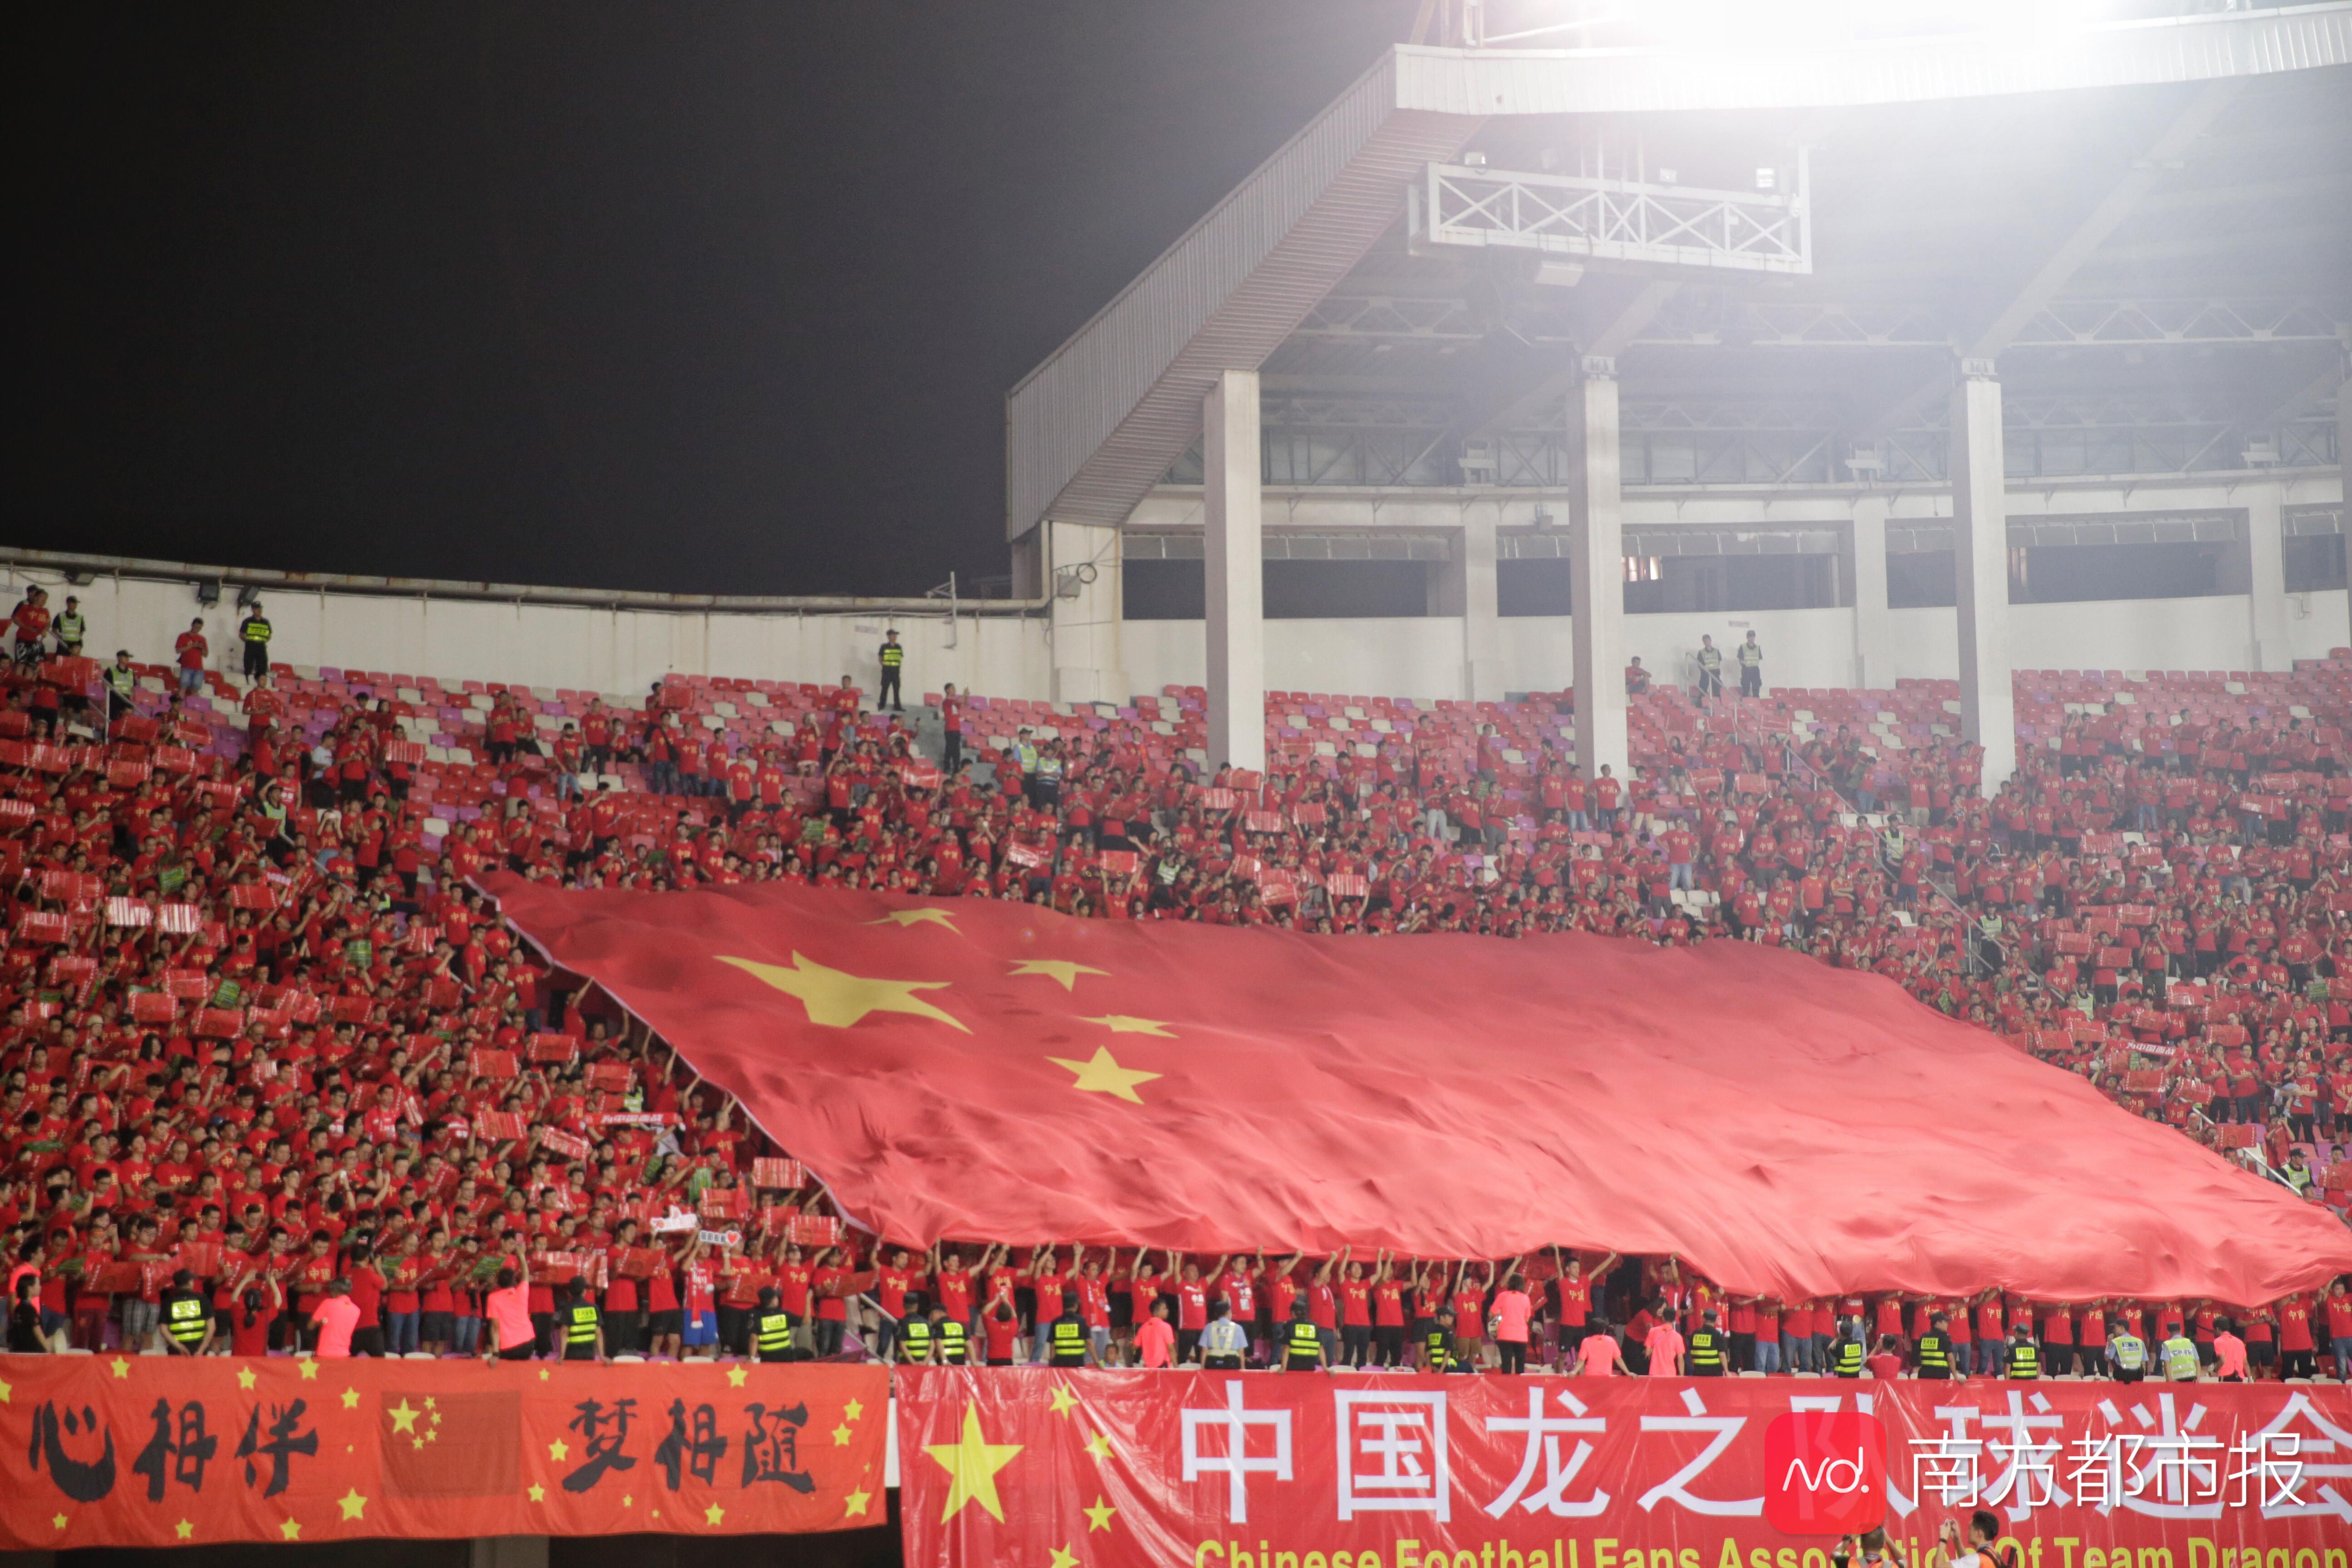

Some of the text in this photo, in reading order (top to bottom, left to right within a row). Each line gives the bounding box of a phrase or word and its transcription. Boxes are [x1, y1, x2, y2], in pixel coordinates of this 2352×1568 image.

[29, 611, 47, 622] 中国
[590, 720, 605, 729] 中国
[683, 745, 698, 754] 中国
[1421, 762, 1434, 771] 中国
[736, 772, 750, 781] 中国
[765, 774, 779, 783] 中国
[70, 787, 87, 796] 中国
[1572, 785, 1584, 793] 中国
[1600, 785, 1614, 794] 中国
[599, 805, 612, 814] 中国
[1398, 806, 1411, 814] 中国
[1465, 802, 1479, 813] 中国
[1740, 808, 1754, 817] 中国
[478, 830, 493, 838] 中国
[1672, 837, 1689, 845] 中国
[943, 849, 958, 859] 中国
[1788, 848, 1803, 856] 中国
[464, 853, 479, 864] 中国
[710, 857, 722, 866] 中国
[881, 853, 895, 862] 中国
[336, 865, 353, 875] 中国
[1582, 868, 1595, 877] 中国
[903, 876, 917, 885] 中国
[1721, 876, 1735, 885] 中国
[2016, 877, 2031, 886] 中国
[1745, 900, 1759, 908] 中国
[1774, 897, 1788, 906] 中国
[451, 912, 467, 923] 中国
[2146, 946, 2161, 955] 中国
[2287, 945, 2301, 953] 中国
[14, 954, 31, 966] 中国
[193, 954, 213, 964] 中国
[516, 973, 534, 985] 中国
[2054, 977, 2068, 985] 中国
[2272, 971, 2284, 981] 中国
[2126, 1042, 2176, 1055] 为中国而战
[29, 1083, 50, 1093] 中国
[2341, 1083, 2352, 1093] 中国
[570, 1107, 583, 1118] 中国
[718, 1140, 731, 1152] 中国
[619, 1147, 640, 1157] 中国
[477, 1169, 493, 1179] 中国
[308, 1268, 331, 1280] 中国
[399, 1269, 417, 1282] 中国
[789, 1272, 808, 1283] 中国
[887, 1276, 907, 1290] 中国
[947, 1281, 966, 1293] 中国
[1281, 1283, 1295, 1293] 中国
[1044, 1284, 1061, 1296] 中国
[1140, 1286, 1157, 1297] 中国
[1350, 1289, 1366, 1299] 中国
[1382, 1289, 1400, 1299] 中国
[1191, 1294, 1205, 1303] 中国
[1569, 1290, 1584, 1302] 中国
[1463, 1301, 1477, 1312] 中国
[1885, 1300, 1900, 1310] 中国
[2333, 1303, 2351, 1312] 中国
[1950, 1308, 1967, 1319] 中国
[1987, 1308, 2002, 1318] 中国
[2018, 1306, 2032, 1316] 中国
[2089, 1310, 2102, 1319] 中国
[2125, 1309, 2141, 1319] 中国
[2288, 1309, 2305, 1321] 中国
[28, 1395, 817, 1503] 心相伴 梦相随
[1195, 1539, 1382, 1568] Chinese
[1396, 1539, 1577, 1568] Football
[1593, 1538, 1700, 1568] Fans
[2053, 1537, 2173, 1568] Team
